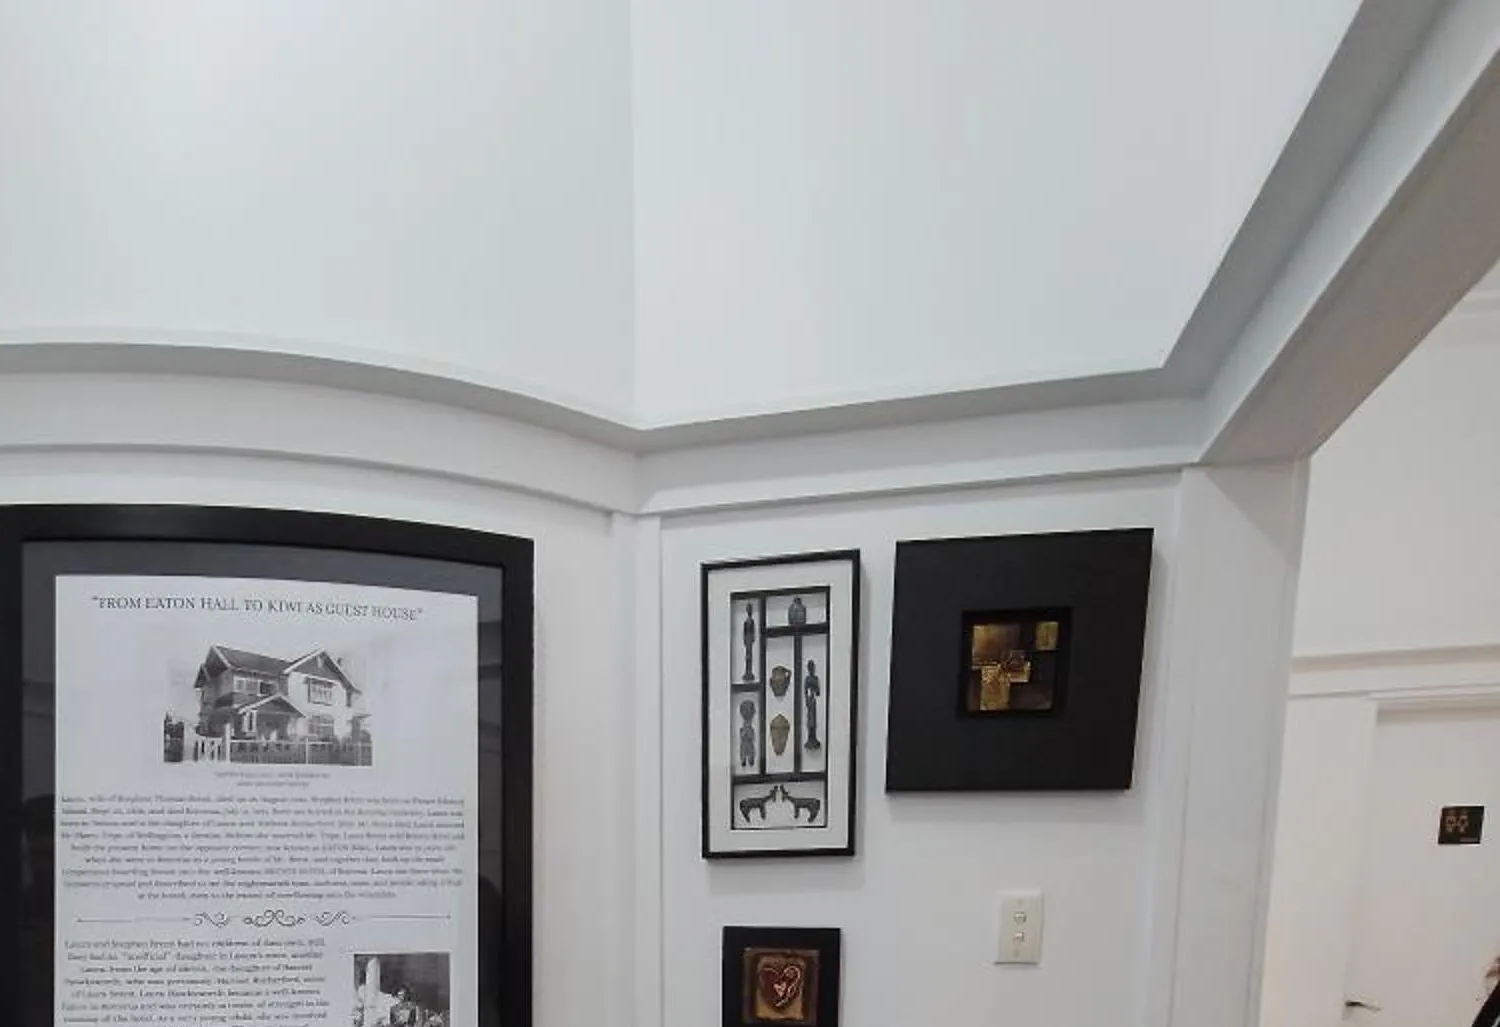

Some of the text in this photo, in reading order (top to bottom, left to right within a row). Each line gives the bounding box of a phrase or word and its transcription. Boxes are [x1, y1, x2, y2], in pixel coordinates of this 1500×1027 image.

[92, 596, 141, 610] "FROM
[145, 597, 195, 610] EATON
[200, 597, 240, 612] HALL
[243, 599, 263, 612] TO
[268, 600, 302, 614] KIWI
[307, 602, 323, 616] AS
[326, 603, 368, 617] GUEST
